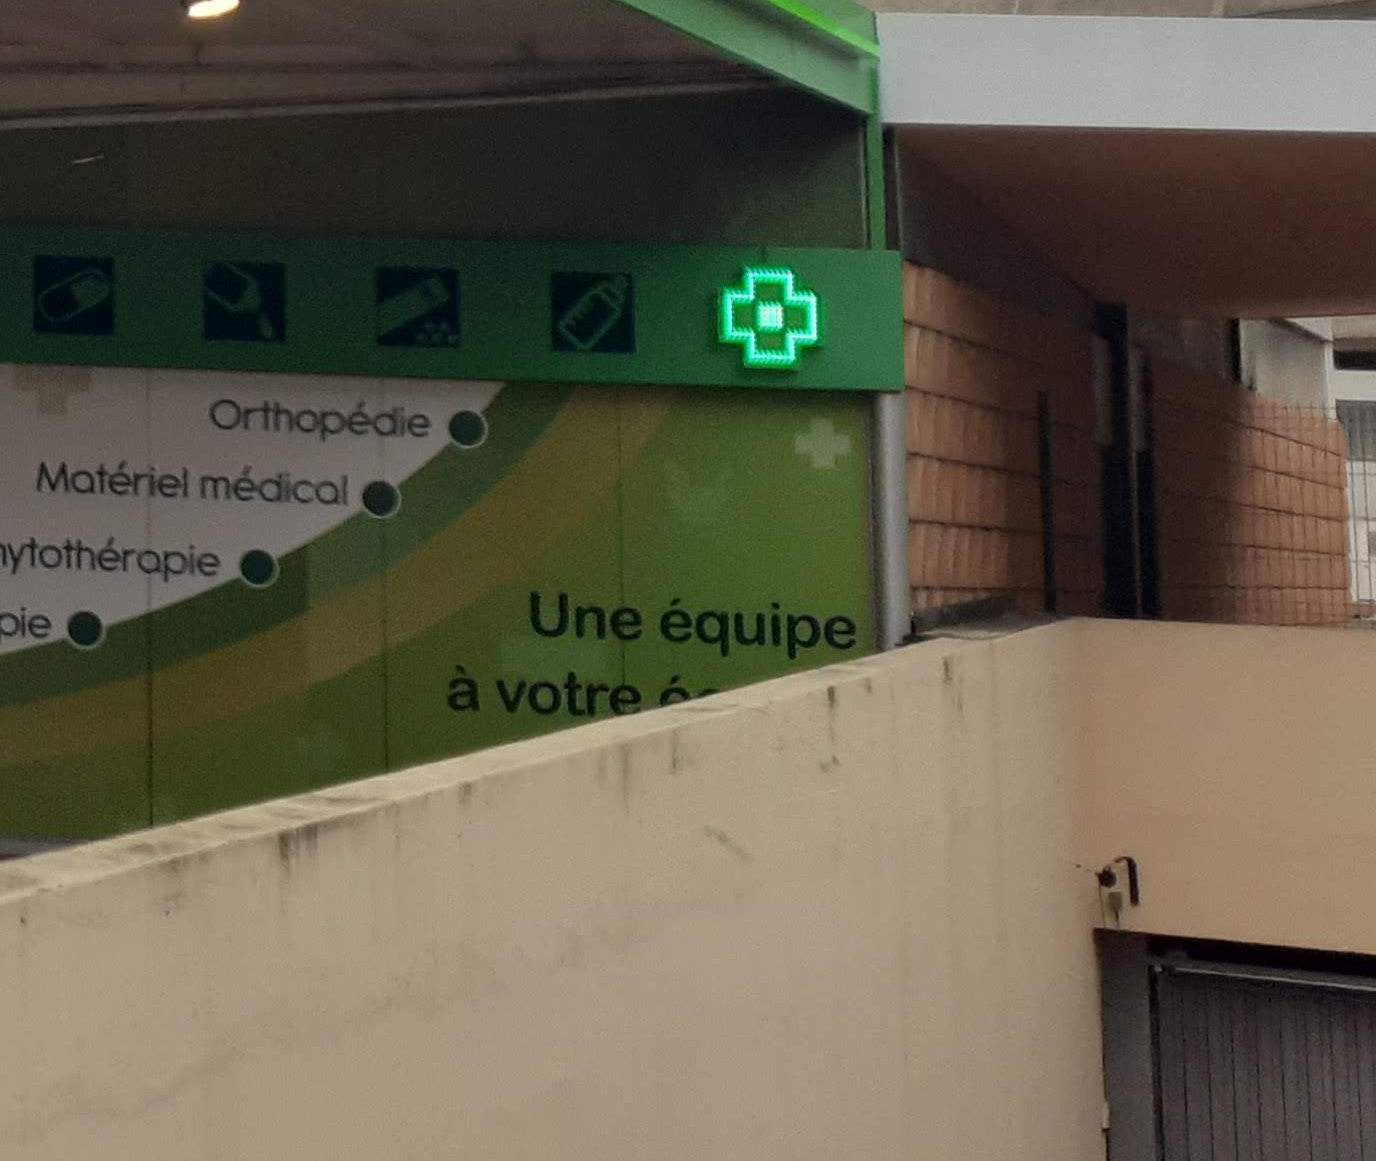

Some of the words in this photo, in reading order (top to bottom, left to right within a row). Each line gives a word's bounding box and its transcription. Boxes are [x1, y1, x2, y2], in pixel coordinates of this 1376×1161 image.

[209, 399, 431, 441] Orthopédie
[35, 460, 188, 498] Matériel
[199, 466, 348, 507] médical
[529, 590, 643, 640] Une
[659, 598, 857, 660] équipe
[448, 665, 481, 712] à
[495, 671, 643, 717] votre
